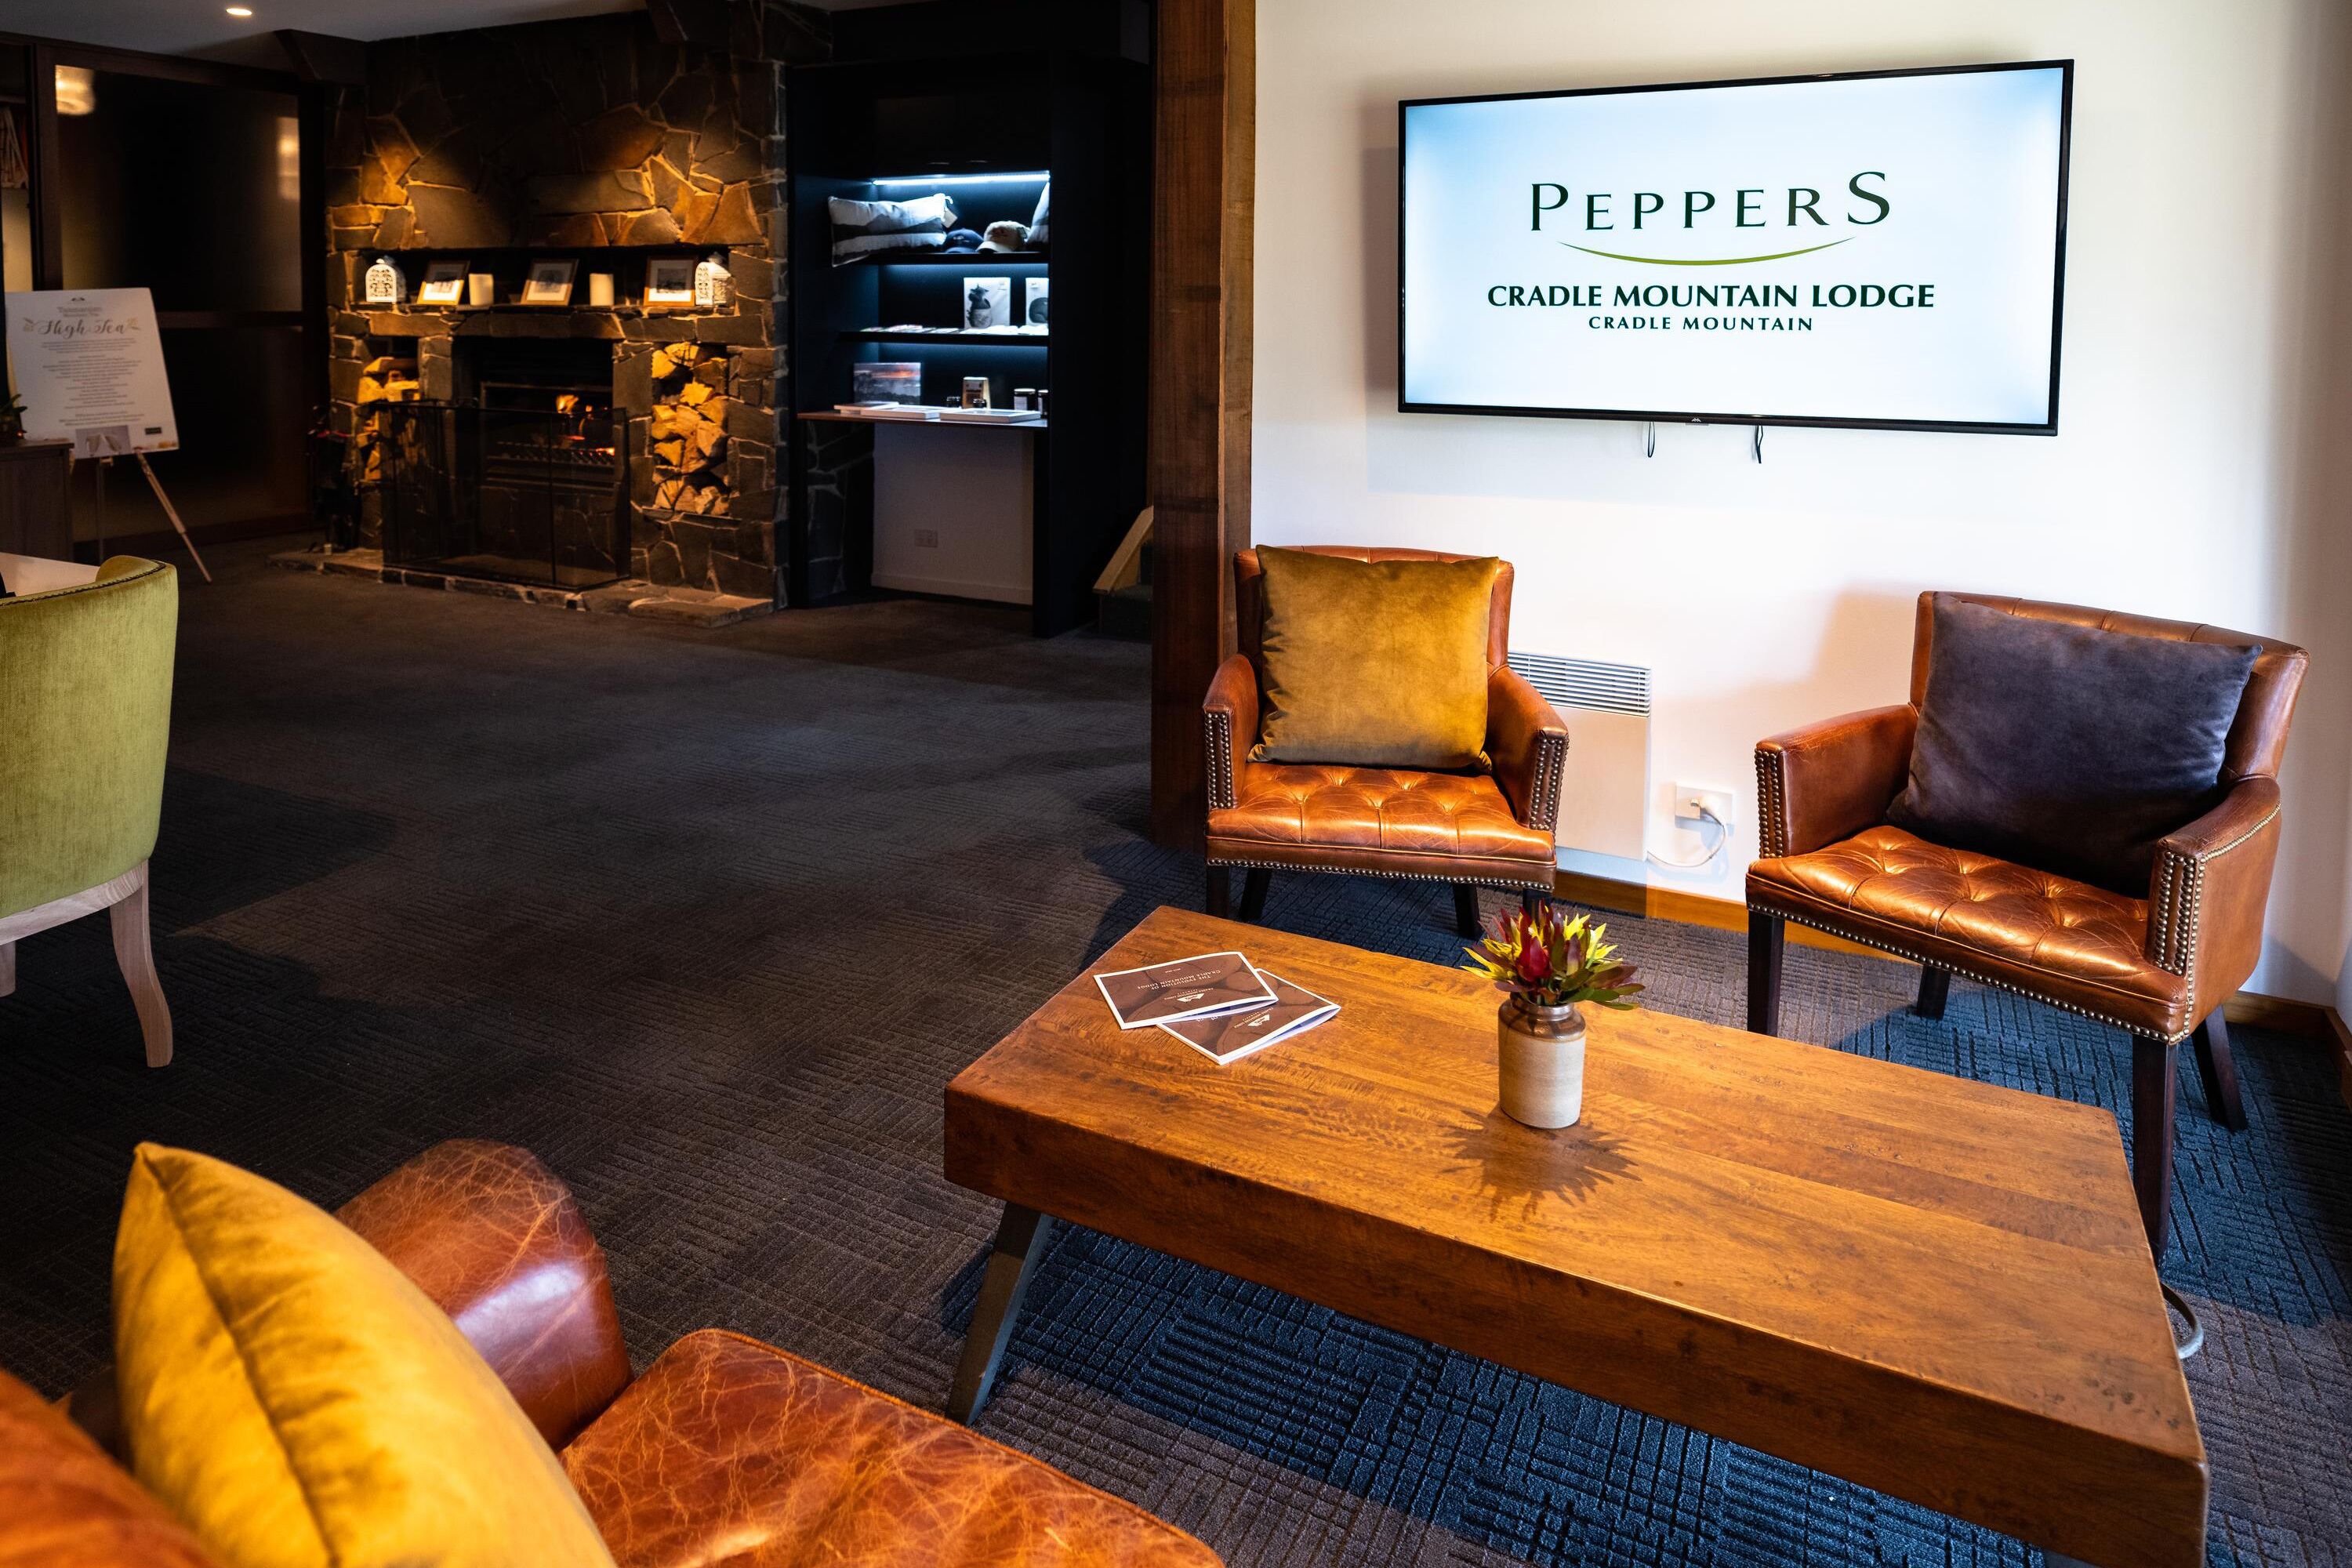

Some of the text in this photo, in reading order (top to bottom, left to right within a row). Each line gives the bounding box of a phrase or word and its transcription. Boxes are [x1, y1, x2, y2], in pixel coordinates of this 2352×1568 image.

[1530, 171, 1890, 231] PEPPERS
[1487, 284, 1935, 308] CRADLE MOUNTAIN LODGE
[38, 318, 125, 339] High Tea
[1588, 316, 1812, 331] CRADLE MOUNTAIN
